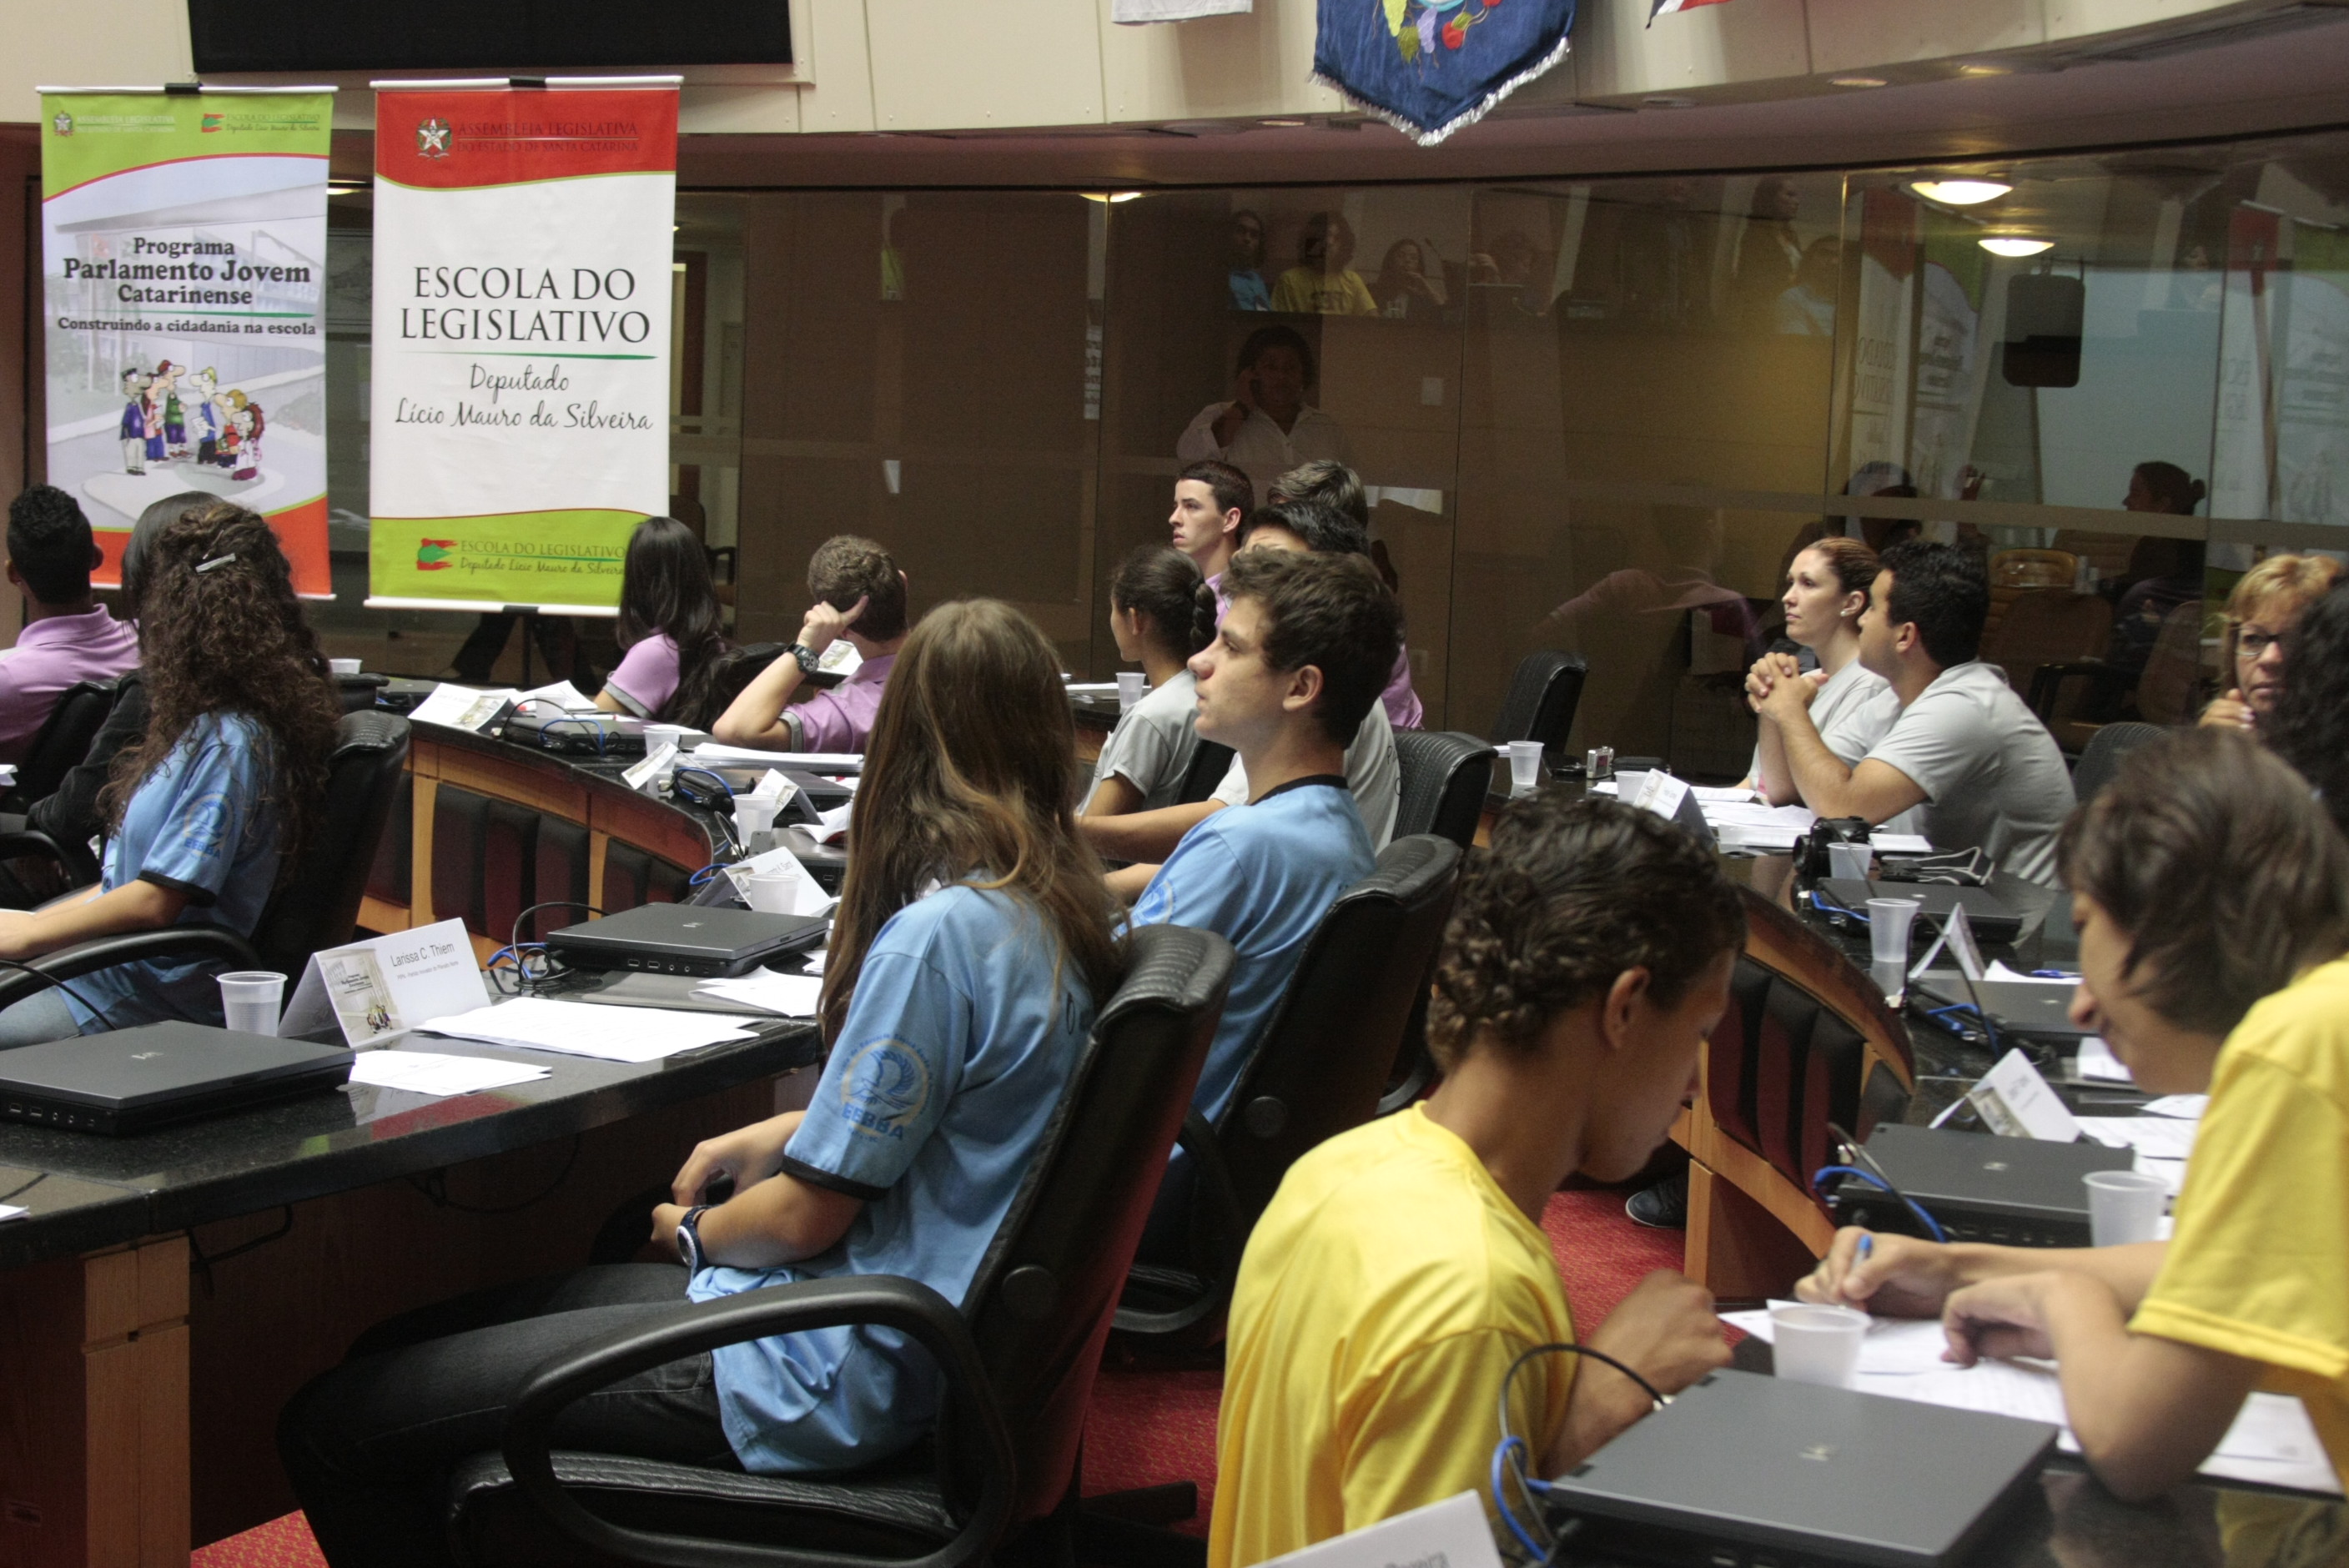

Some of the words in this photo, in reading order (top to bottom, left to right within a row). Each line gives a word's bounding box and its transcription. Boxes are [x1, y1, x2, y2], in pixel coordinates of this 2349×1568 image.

[459, 123, 542, 135] ASSEMBLEIA
[548, 122, 638, 136] LEGISLATIVA
[543, 142, 577, 153] SANTA
[581, 142, 639, 153] CATARINA
[133, 237, 235, 259] Programa
[63, 259, 214, 281] Parlamento
[220, 259, 311, 283] Jovem
[118, 285, 253, 304] Catarinense
[413, 266, 563, 300] ESCOLA
[571, 268, 636, 301] DO
[58, 317, 151, 332] Construindo
[155, 323, 163, 332] a
[167, 319, 239, 334] cidadania
[244, 324, 263, 334] na
[268, 320, 316, 335] escola
[400, 307, 651, 344] LEGISLATIVO
[469, 363, 570, 405] Deputado
[395, 397, 445, 425] Lício
[449, 401, 522, 428] Mauro
[529, 400, 559, 428] da
[563, 400, 654, 430] Silveira
[461, 540, 510, 554] ESCOLA
[514, 543, 536, 555] DO
[540, 544, 626, 558] LEGISLATIVO
[460, 557, 506, 575] Deputado
[571, 560, 583, 574] da
[390, 952, 420, 967] Larissa
[420, 947, 430, 960] C.
[430, 943, 455, 957] Thiem
[842, 1102, 903, 1141] EEBBA
